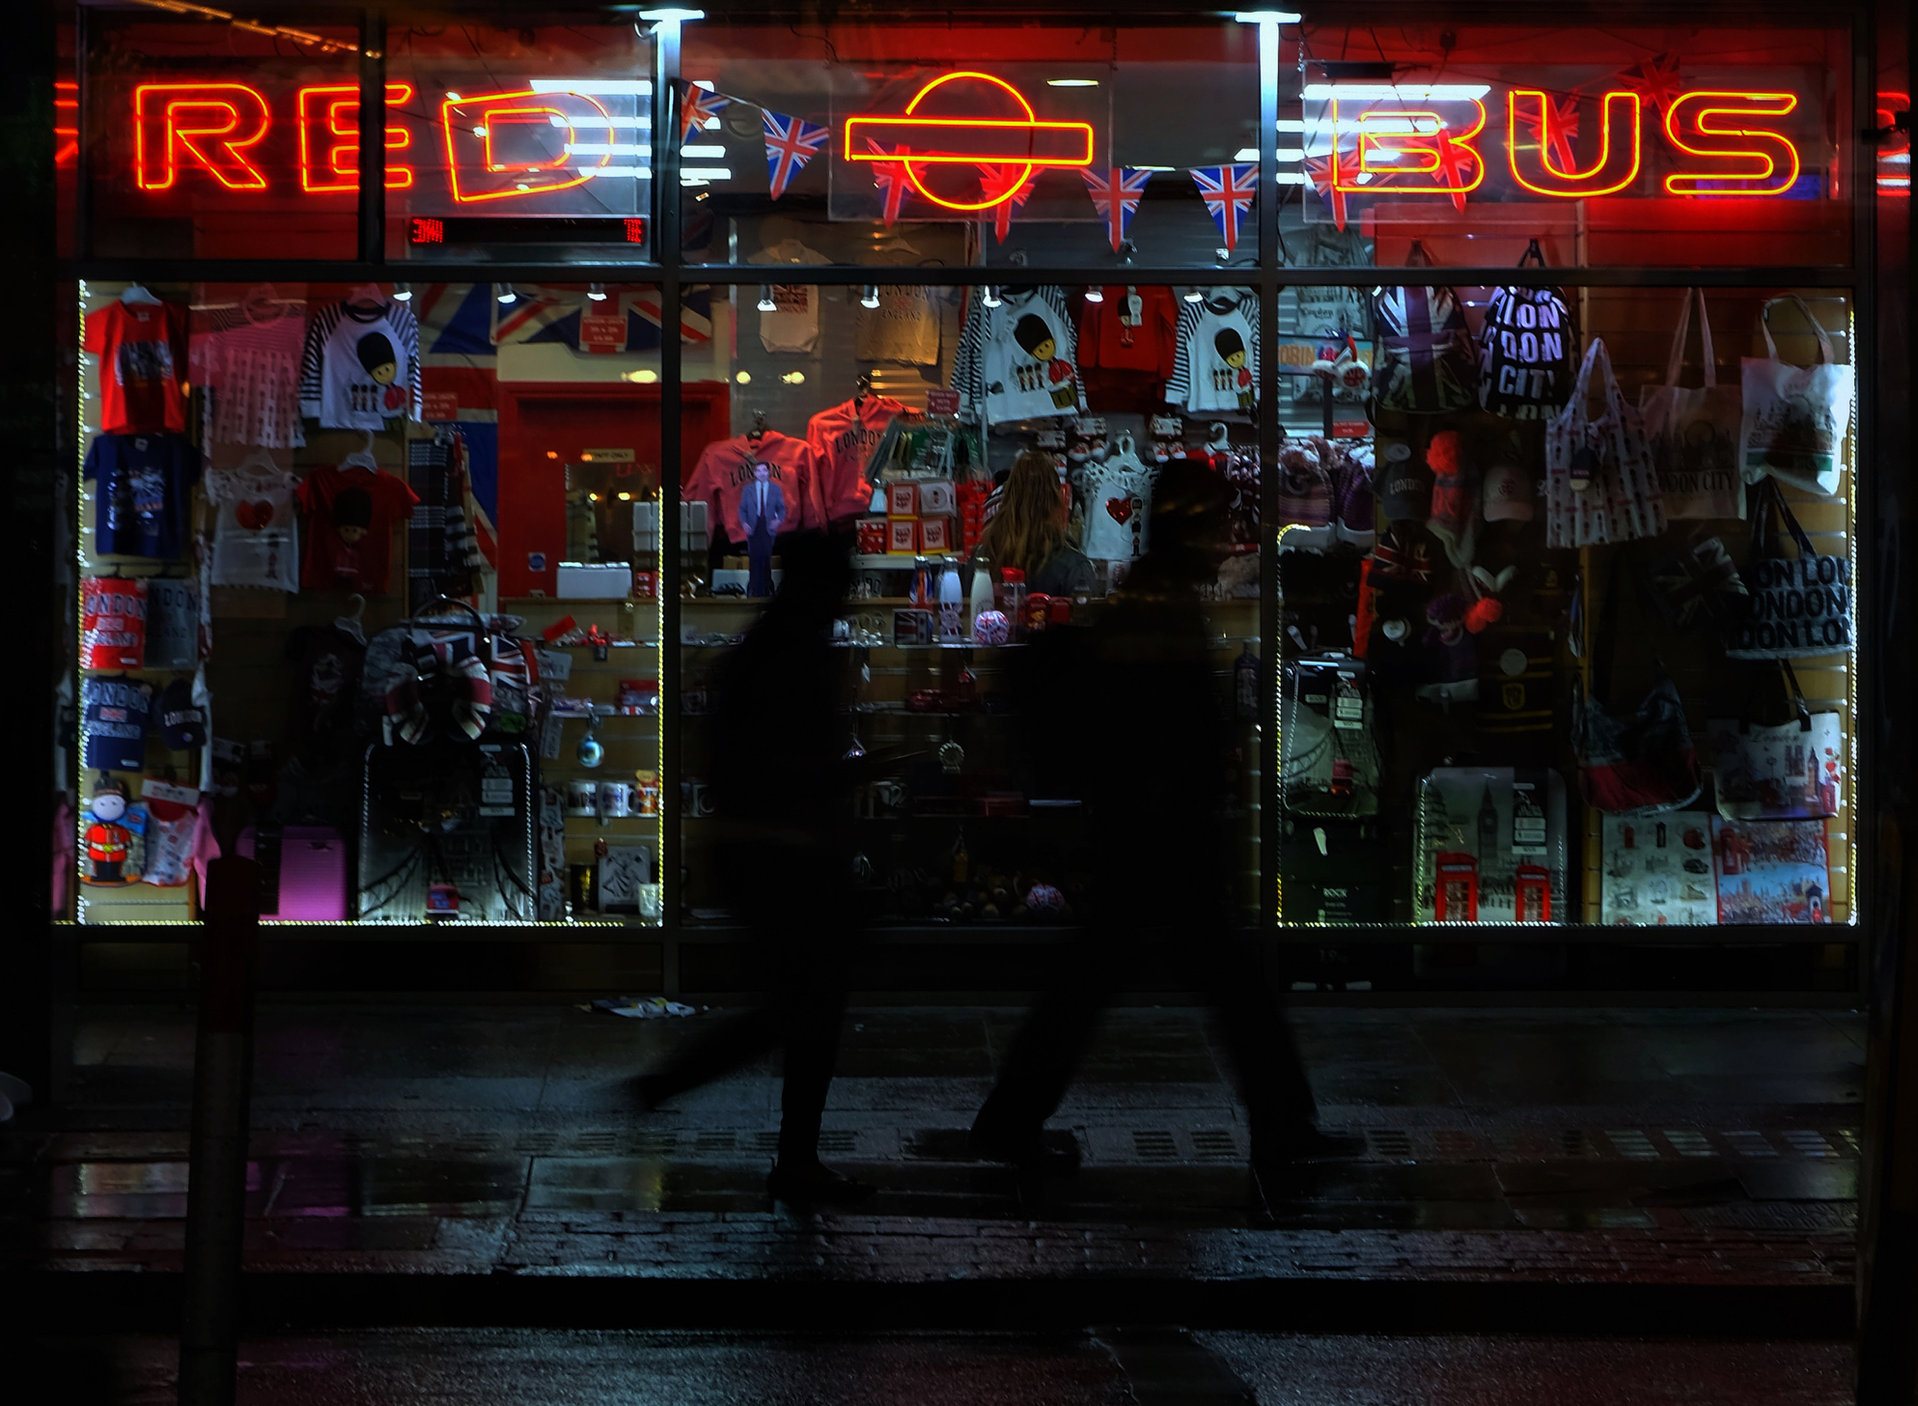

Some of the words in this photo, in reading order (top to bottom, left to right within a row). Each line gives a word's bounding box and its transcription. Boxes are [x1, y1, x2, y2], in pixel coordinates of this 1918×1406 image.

[133, 82, 617, 204] RED
[1332, 86, 1801, 198] BUS
[1502, 297, 1561, 330] LON
[1500, 330, 1563, 364] DON
[729, 463, 781, 487] LONON
[85, 594, 147, 620] ONDON
[1751, 586, 1848, 620] ONDON
[84, 682, 149, 714] ONDON
